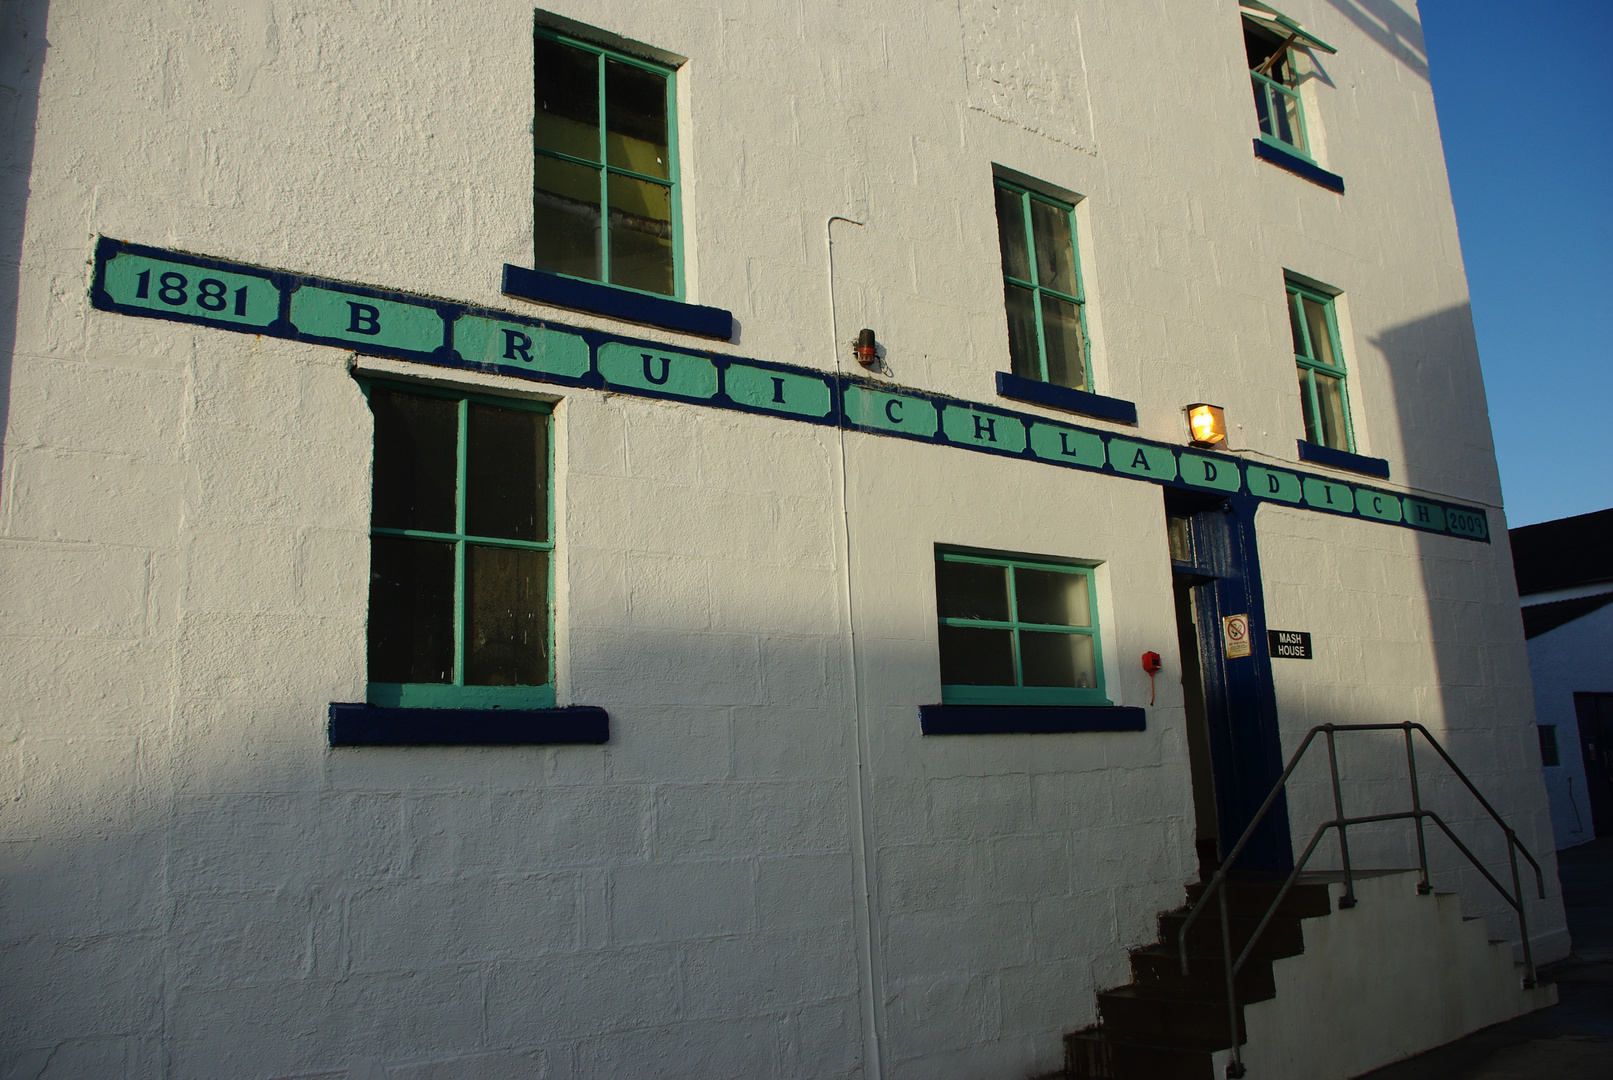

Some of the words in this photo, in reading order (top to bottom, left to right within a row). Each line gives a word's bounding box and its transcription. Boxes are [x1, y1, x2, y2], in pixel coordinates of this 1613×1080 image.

[136, 269, 247, 317] 1881
[1450, 512, 1483, 534] 2009
[1279, 632, 1302, 644] MASH
[1278, 645, 1305, 657] HOUSE
